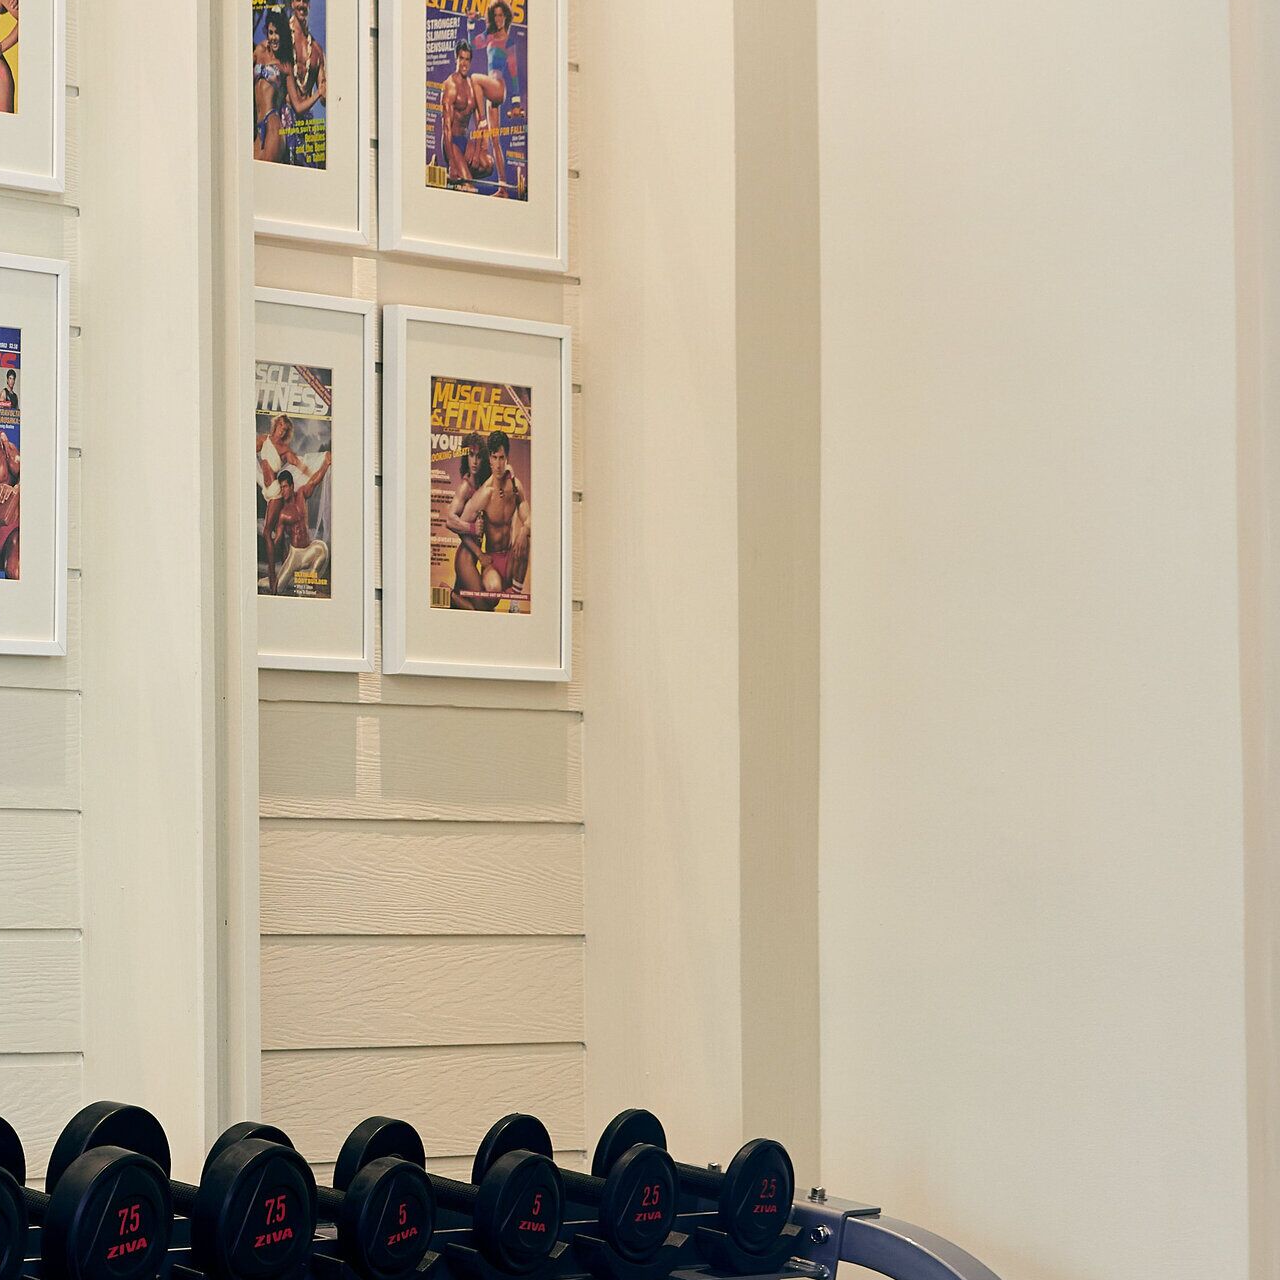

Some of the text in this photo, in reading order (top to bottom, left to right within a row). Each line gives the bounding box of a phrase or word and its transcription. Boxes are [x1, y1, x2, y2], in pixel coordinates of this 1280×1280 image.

[427, 17, 460, 30] STRONGER!
[427, 29, 457, 41] SLIMMER!
[427, 41, 455, 53] SENSUAL!
[256, 364, 299, 384] SCLE
[432, 382, 501, 408] MUSCLE
[431, 401, 529, 435] & FITNESS
[432, 434, 462, 451] YOU!
[642, 1184, 661, 1208] 2.5
[760, 1179, 778, 1200] 2.5
[265, 1195, 286, 1226] 7.5
[399, 1203, 408, 1226] 5
[532, 1194, 542, 1216] 5
[752, 1204, 778, 1214] ZIVA
[119, 1205, 141, 1235] 7.5
[519, 1220, 546, 1234] ZIVA
[634, 1211, 663, 1223] ZIVA
[255, 1227, 293, 1248] ZIVA
[387, 1227, 418, 1246] ZIVA
[107, 1237, 148, 1260] ZIVA
